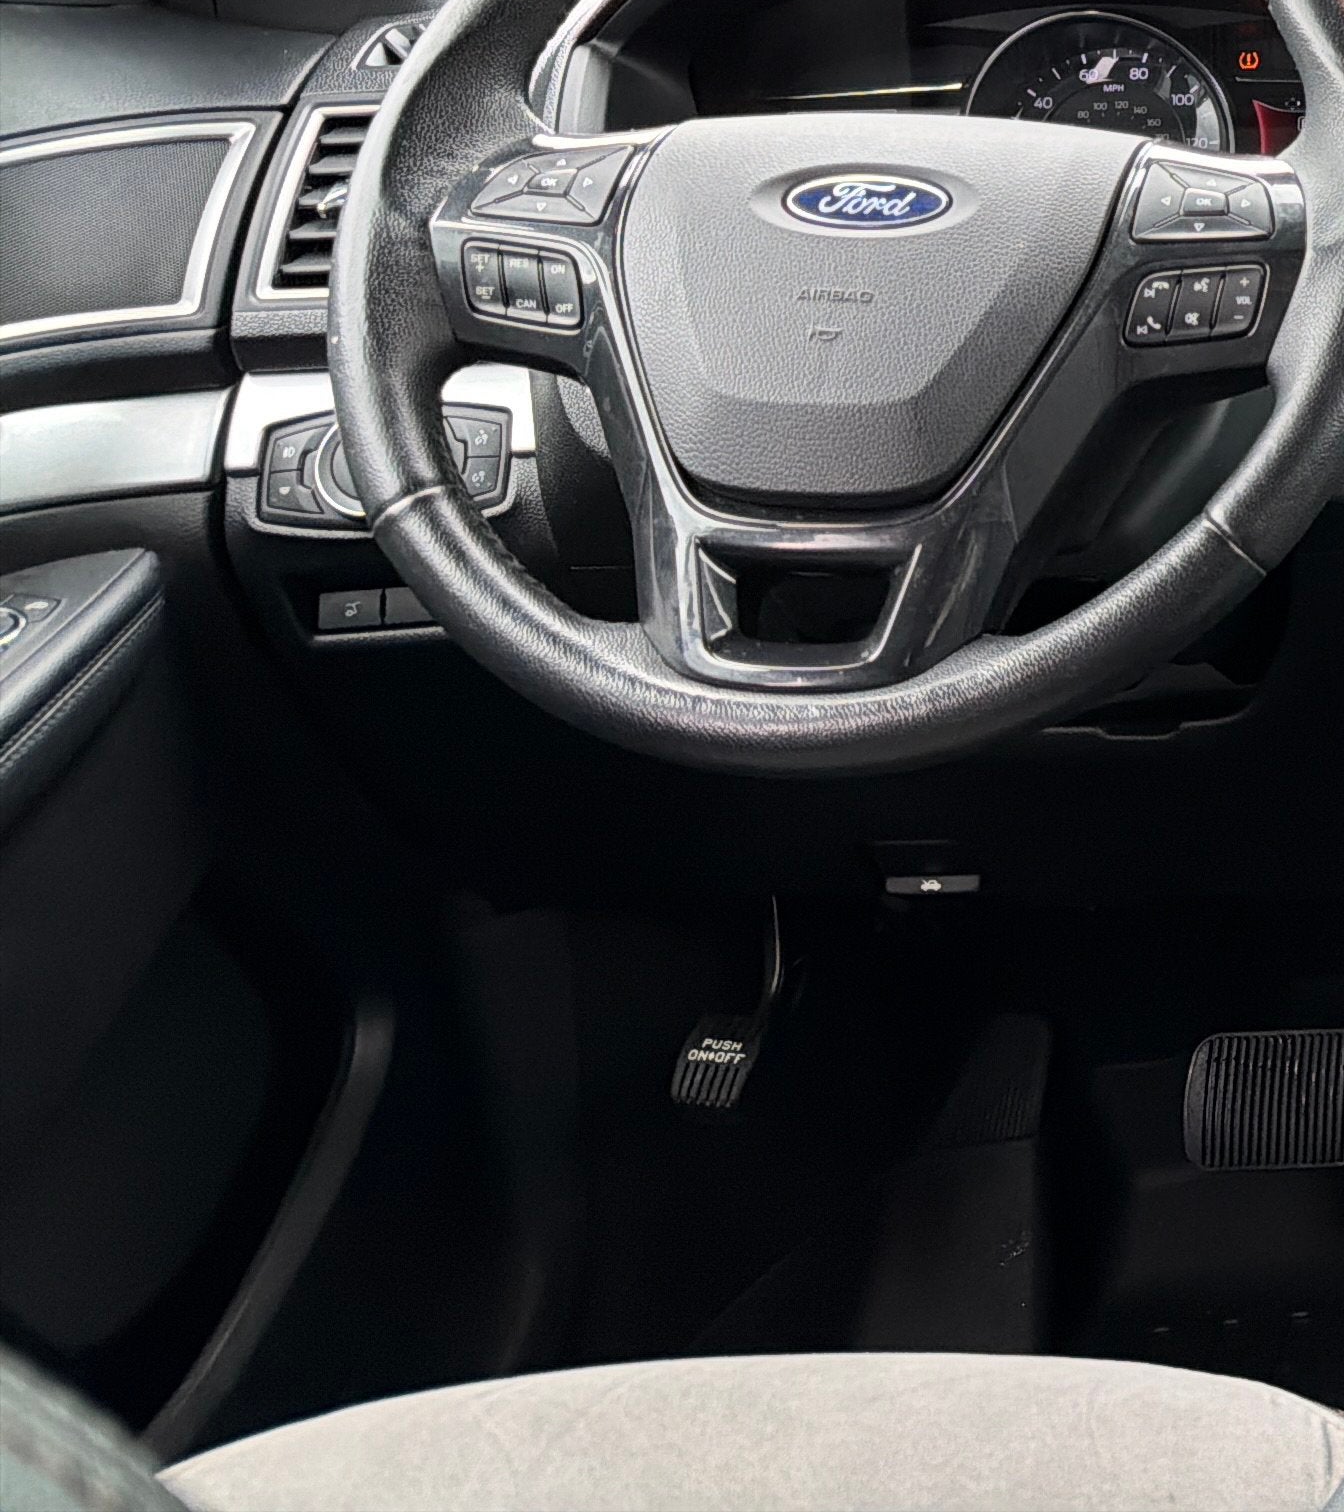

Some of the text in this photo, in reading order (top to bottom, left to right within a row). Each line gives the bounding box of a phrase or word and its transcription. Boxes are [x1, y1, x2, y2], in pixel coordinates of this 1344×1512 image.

[1079, 69, 1099, 81] 60
[1129, 68, 1149, 81] 80
[1103, 84, 1124, 93] MPH
[1033, 97, 1053, 110] 40
[1171, 93, 1195, 106] 100
[818, 183, 916, 216] Ford
[1196, 198, 1212, 206] OK
[471, 254, 490, 264] SET
[551, 265, 566, 275] ON
[475, 287, 495, 296] SET
[797, 289, 875, 304] AIRBAG
[515, 299, 537, 309] CAN
[1236, 296, 1252, 305] VOL
[555, 304, 574, 313] OFF
[702, 1038, 743, 1051] PUSH
